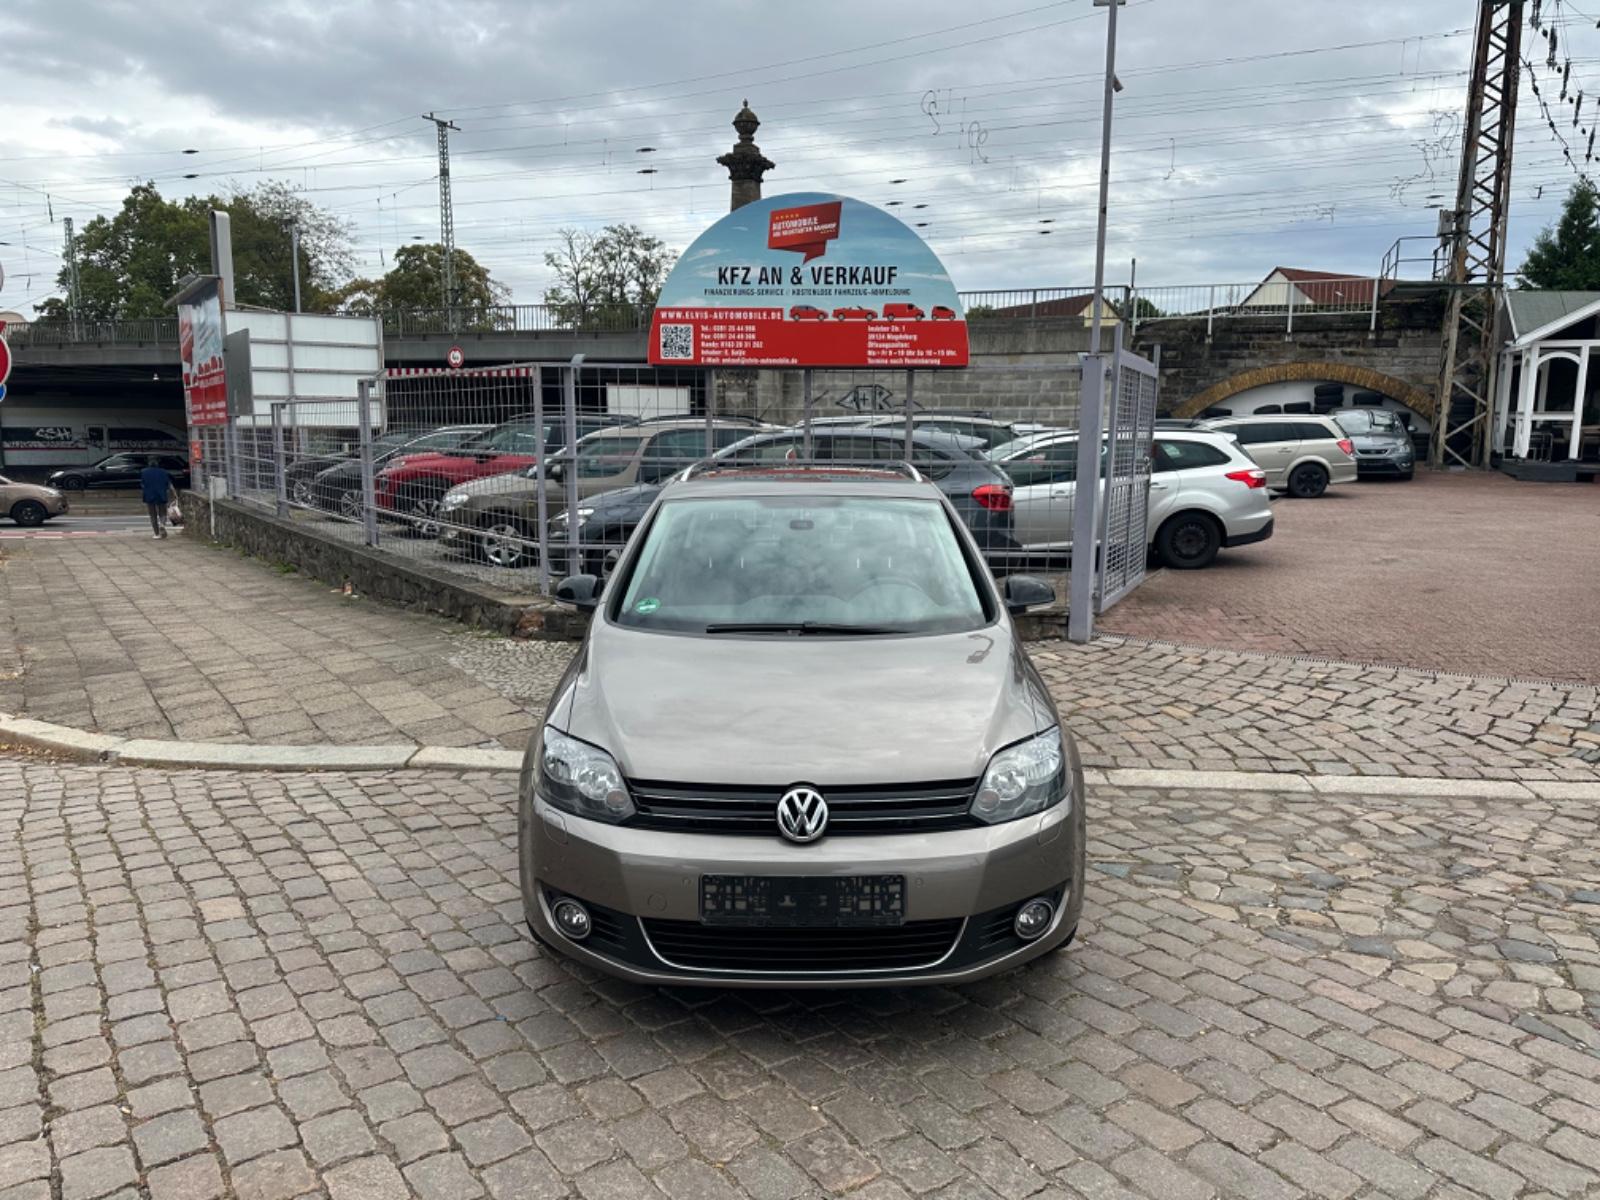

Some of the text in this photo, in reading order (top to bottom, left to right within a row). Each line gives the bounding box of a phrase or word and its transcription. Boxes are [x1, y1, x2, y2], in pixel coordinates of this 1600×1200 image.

[772, 216, 818, 230] AUTOMOBILE
[718, 266, 898, 285] KFZ AN & VERKAUF
[792, 288, 832, 296] KOSTENLOSE
[660, 310, 782, 320] WWW.ELVIS-AUTOMOBILE.DE
